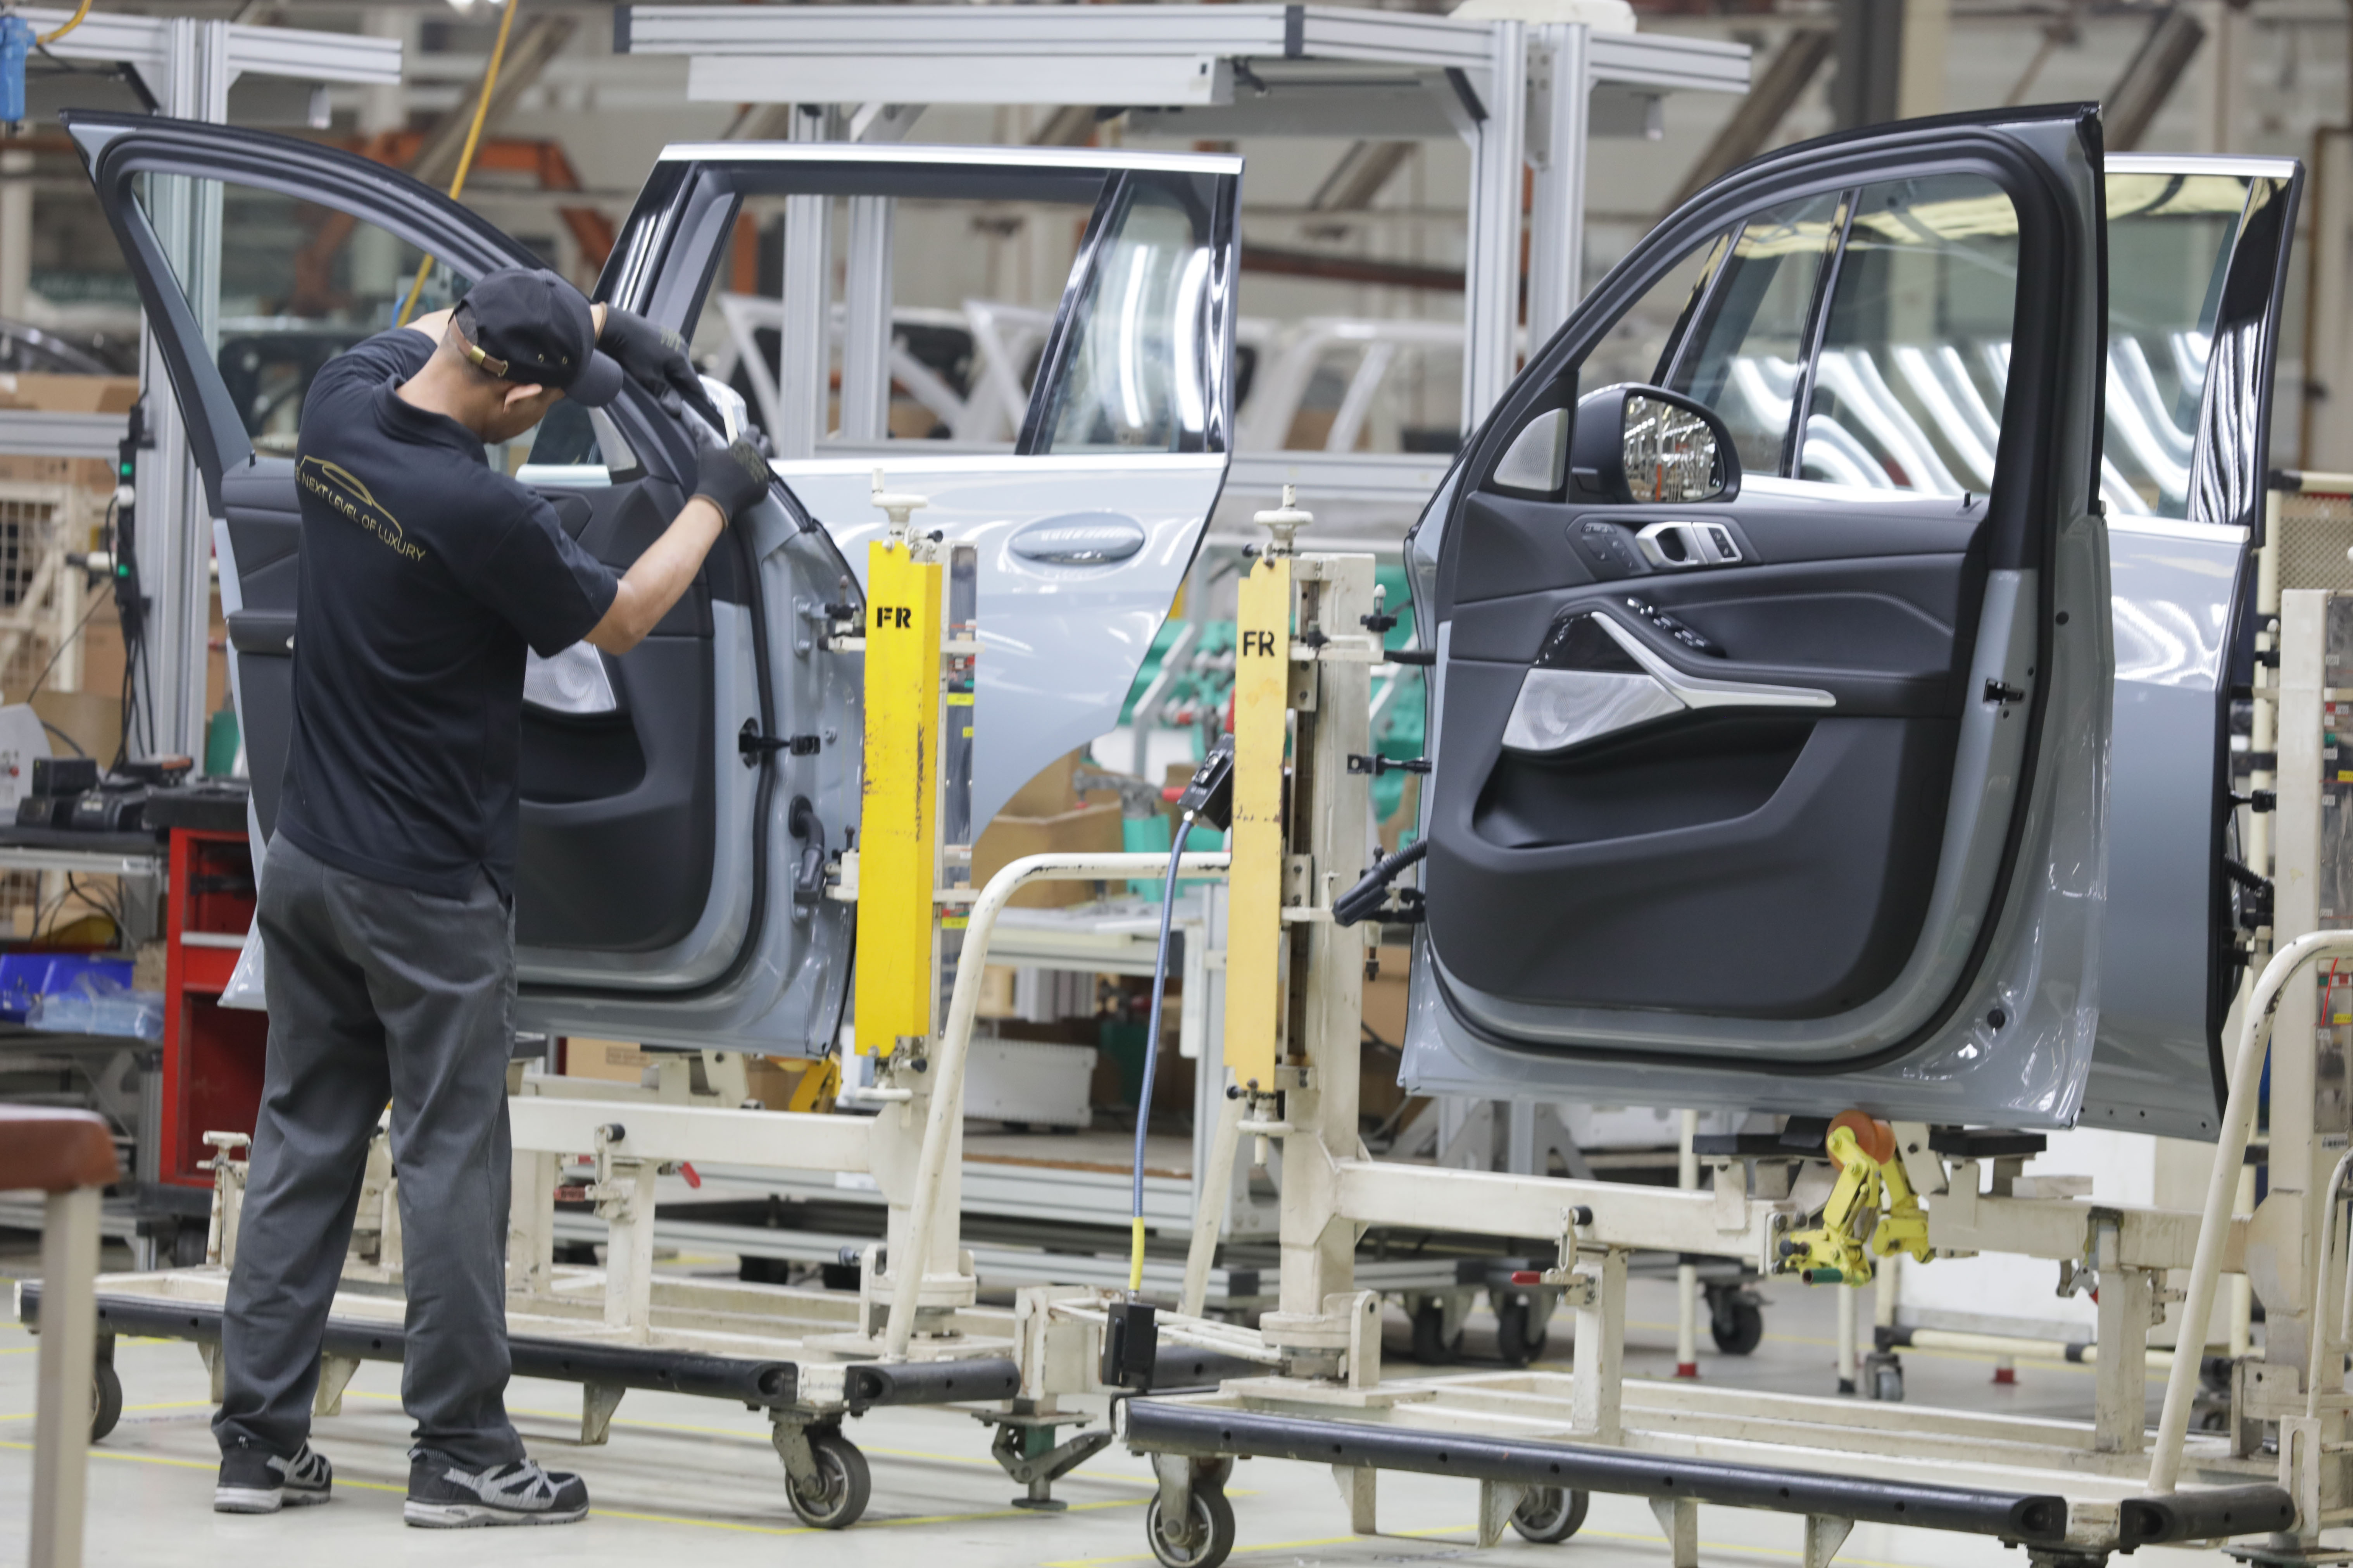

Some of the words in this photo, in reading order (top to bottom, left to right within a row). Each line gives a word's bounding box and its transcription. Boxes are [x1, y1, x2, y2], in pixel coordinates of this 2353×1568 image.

[302, 471, 328, 499] NEXT
[328, 490, 359, 523] LEVEL
[362, 514, 377, 531] OF
[378, 524, 426, 562] LUXURY
[877, 607, 911, 628] FR
[1243, 631, 1275, 656] FR
